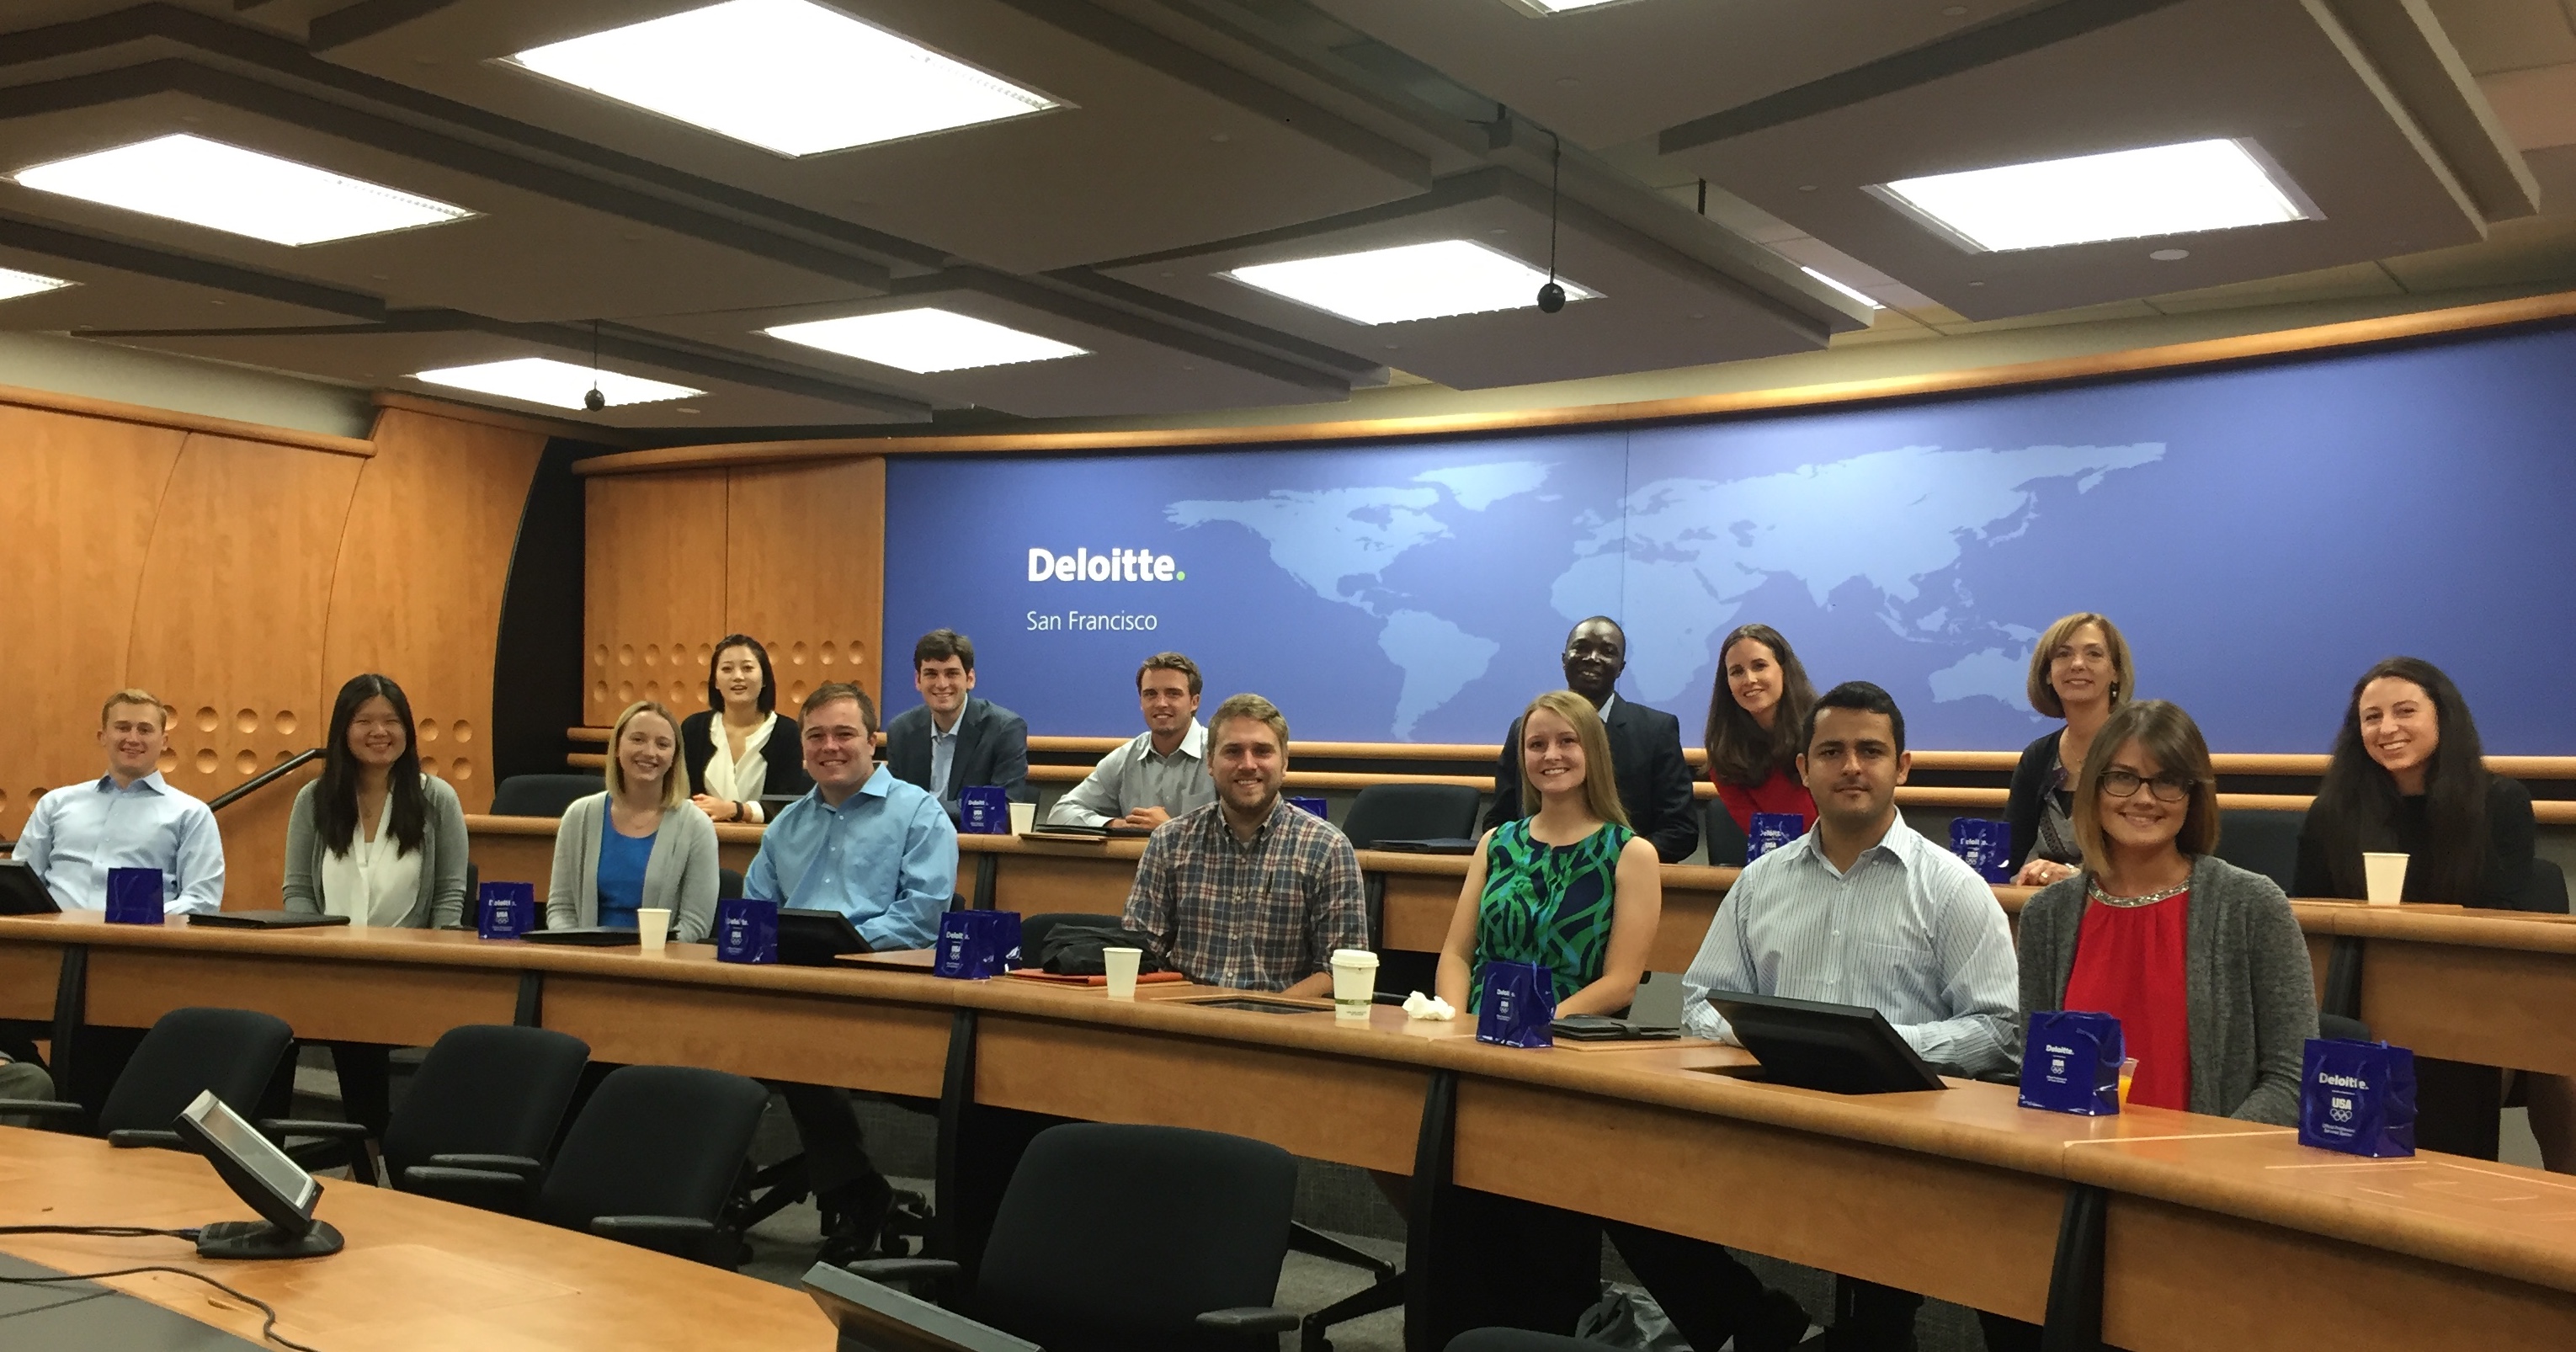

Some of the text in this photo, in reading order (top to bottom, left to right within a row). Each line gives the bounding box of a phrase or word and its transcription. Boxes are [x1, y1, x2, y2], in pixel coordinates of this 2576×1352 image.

[1028, 547, 1185, 582] Deloitte.
[1027, 610, 1158, 631] San Francisco
[2332, 1097, 2352, 1110] USA
